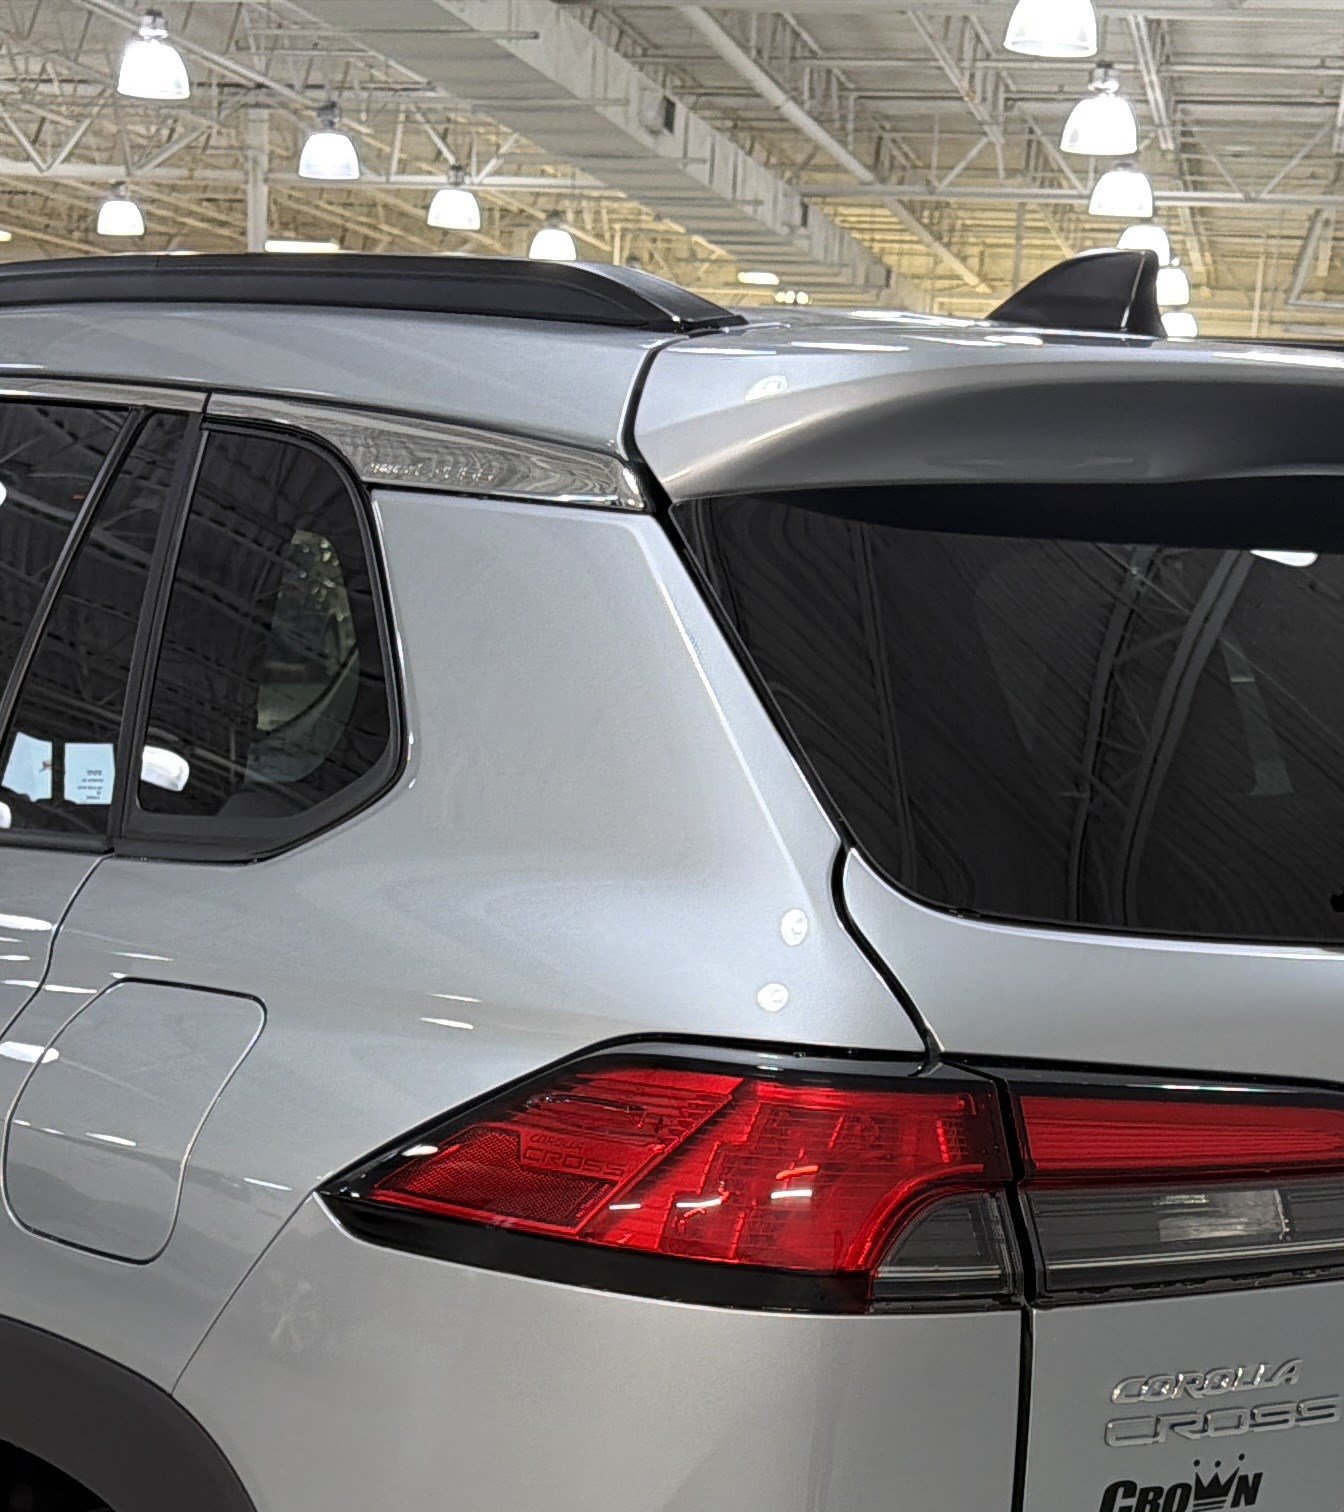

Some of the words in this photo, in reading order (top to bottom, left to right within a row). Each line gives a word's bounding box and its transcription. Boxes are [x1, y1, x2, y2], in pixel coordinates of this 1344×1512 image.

[523, 1146, 627, 1177] CROSS
[1110, 1357, 1303, 1404] COROLLA
[1104, 1393, 1341, 1447] CROSS
